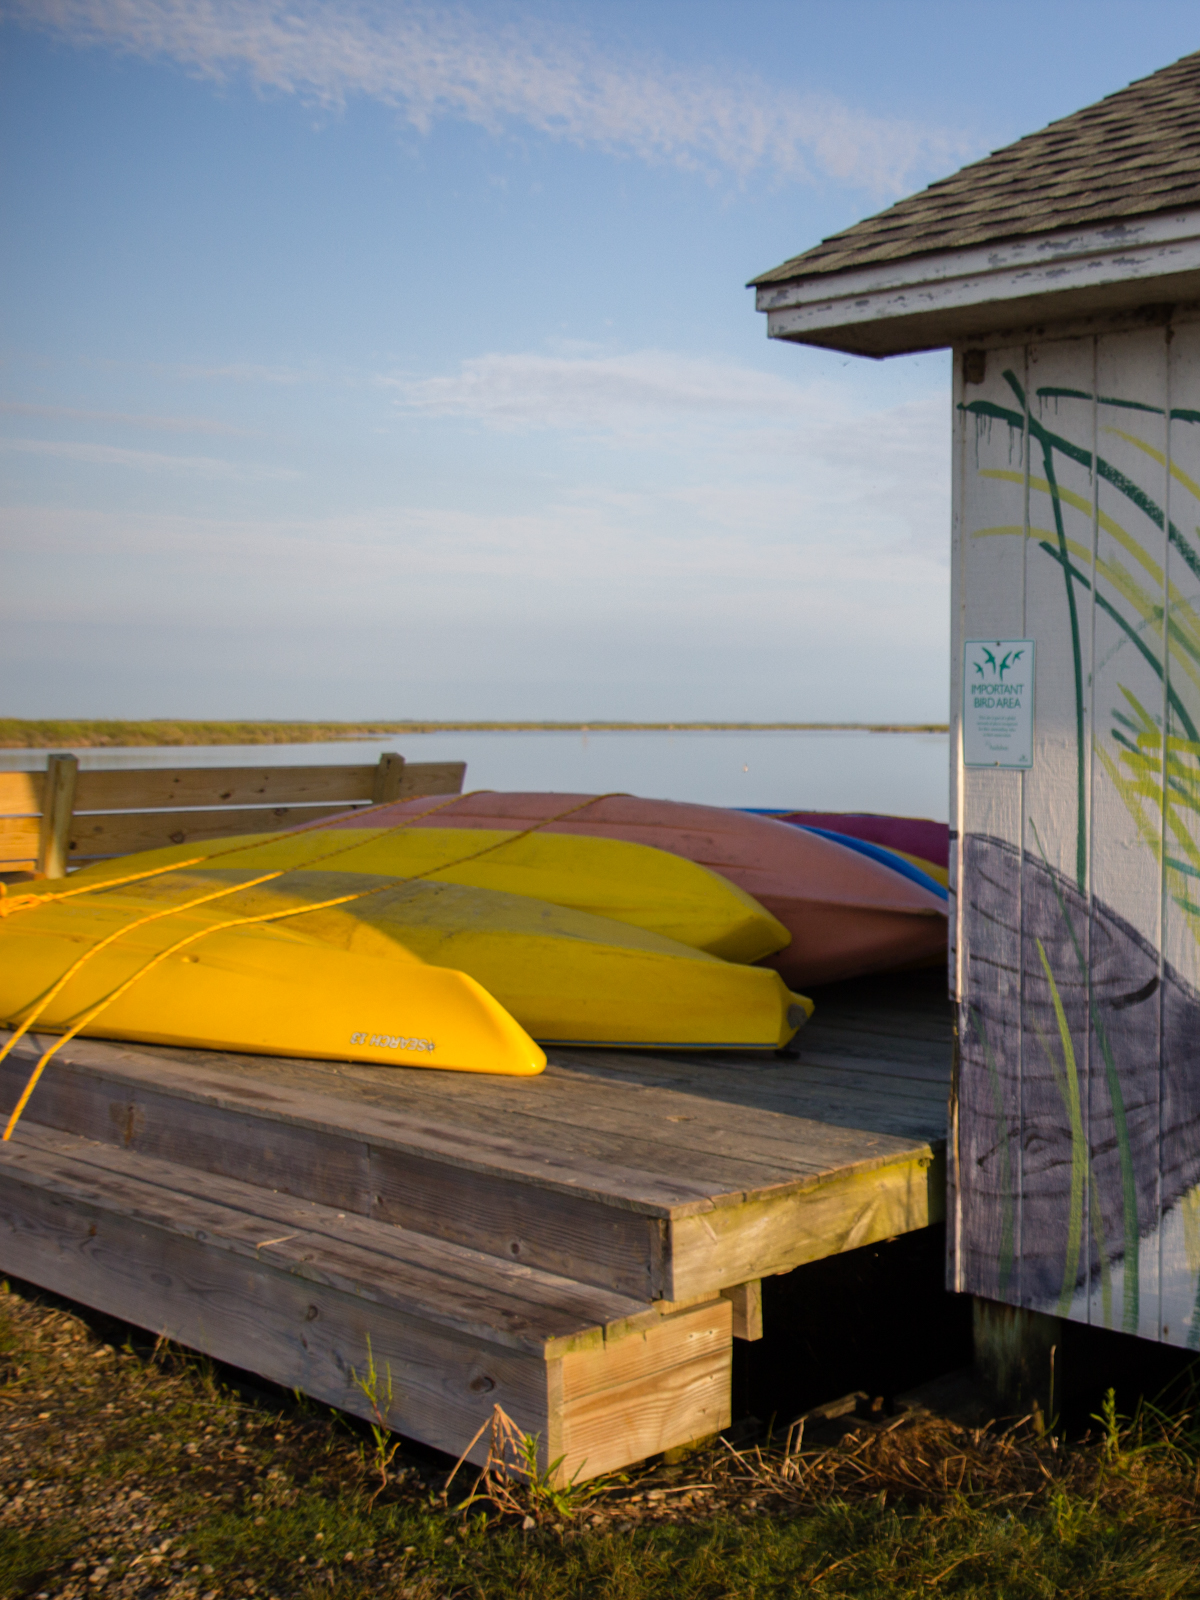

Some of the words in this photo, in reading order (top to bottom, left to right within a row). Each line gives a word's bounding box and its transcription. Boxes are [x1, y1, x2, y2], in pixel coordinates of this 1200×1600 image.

[971, 684, 1024, 696] IMPORTANT
[974, 697, 996, 709] BIRD
[996, 697, 1021, 709] AREA
[350, 1031, 368, 1045] 13
[369, 1034, 429, 1052] SEARCH
